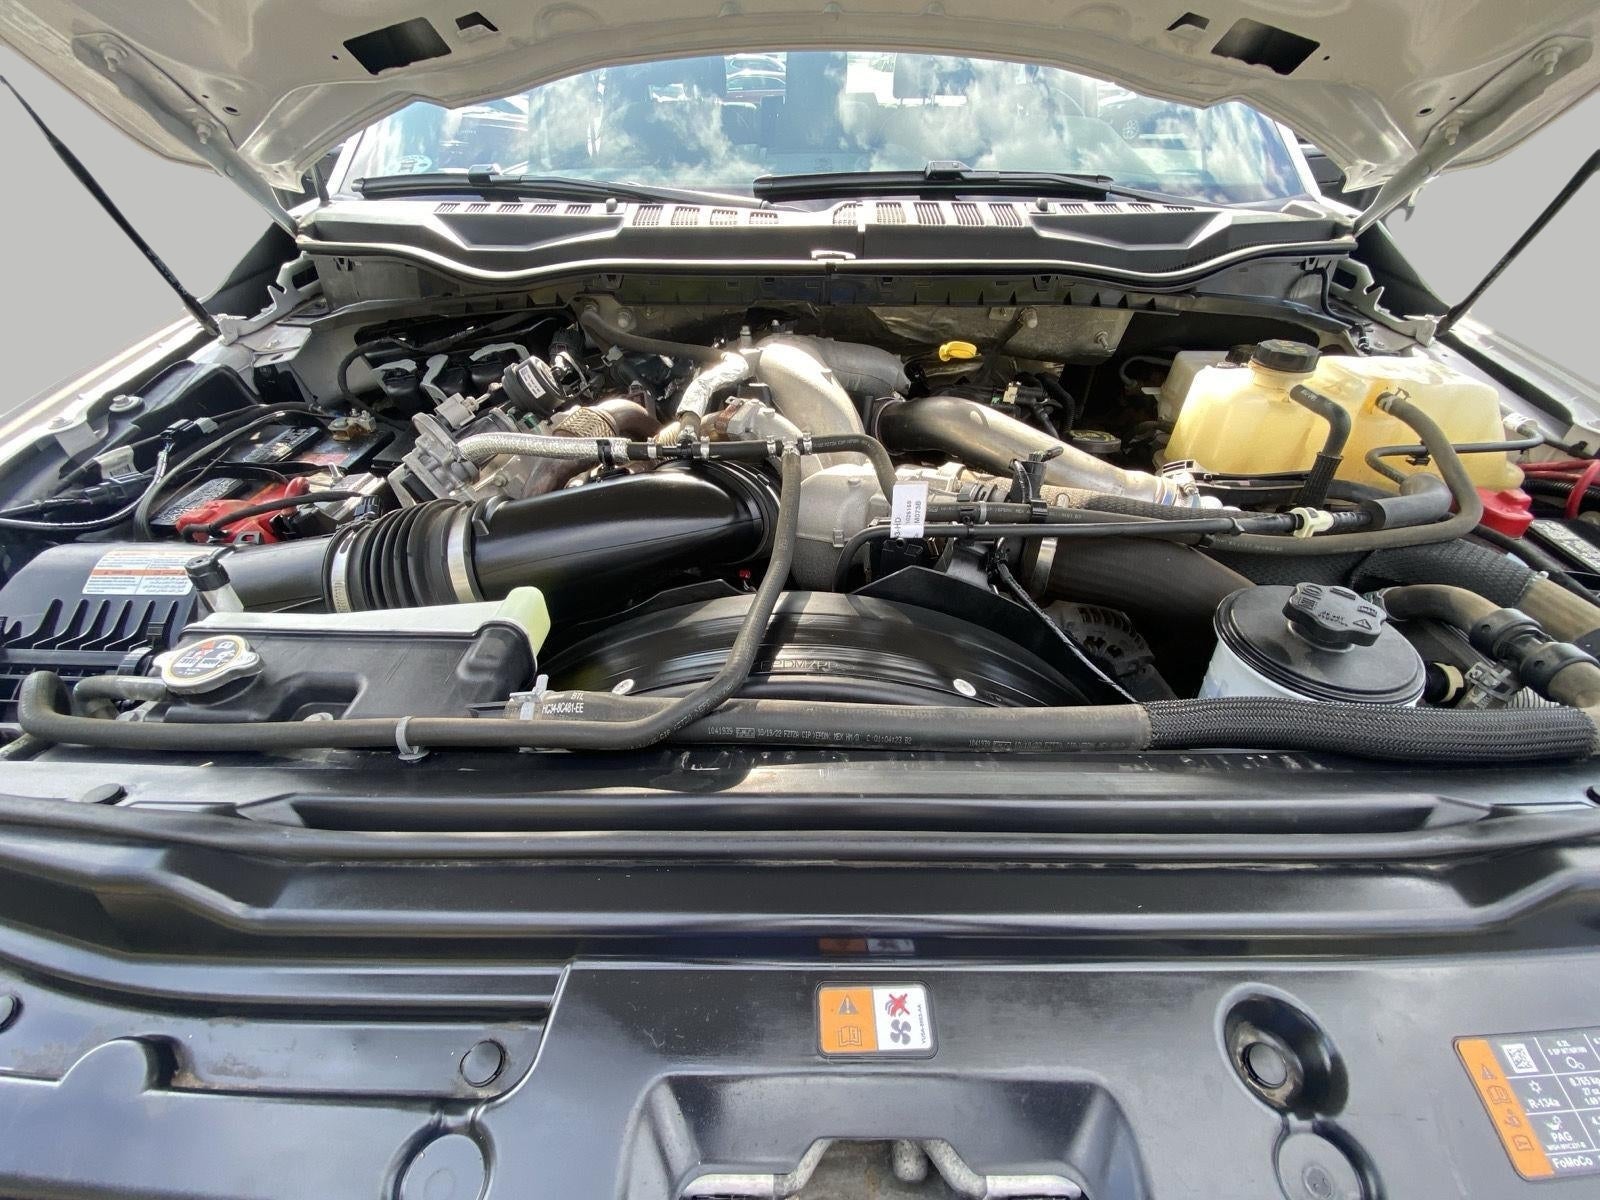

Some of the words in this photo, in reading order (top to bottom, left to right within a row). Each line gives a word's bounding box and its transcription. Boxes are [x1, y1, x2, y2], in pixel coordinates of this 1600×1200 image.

[1526, 1098, 1561, 1109] R-134a
[1551, 1131, 1573, 1143] PAG
[1551, 1155, 1593, 1169] FoMoCo
